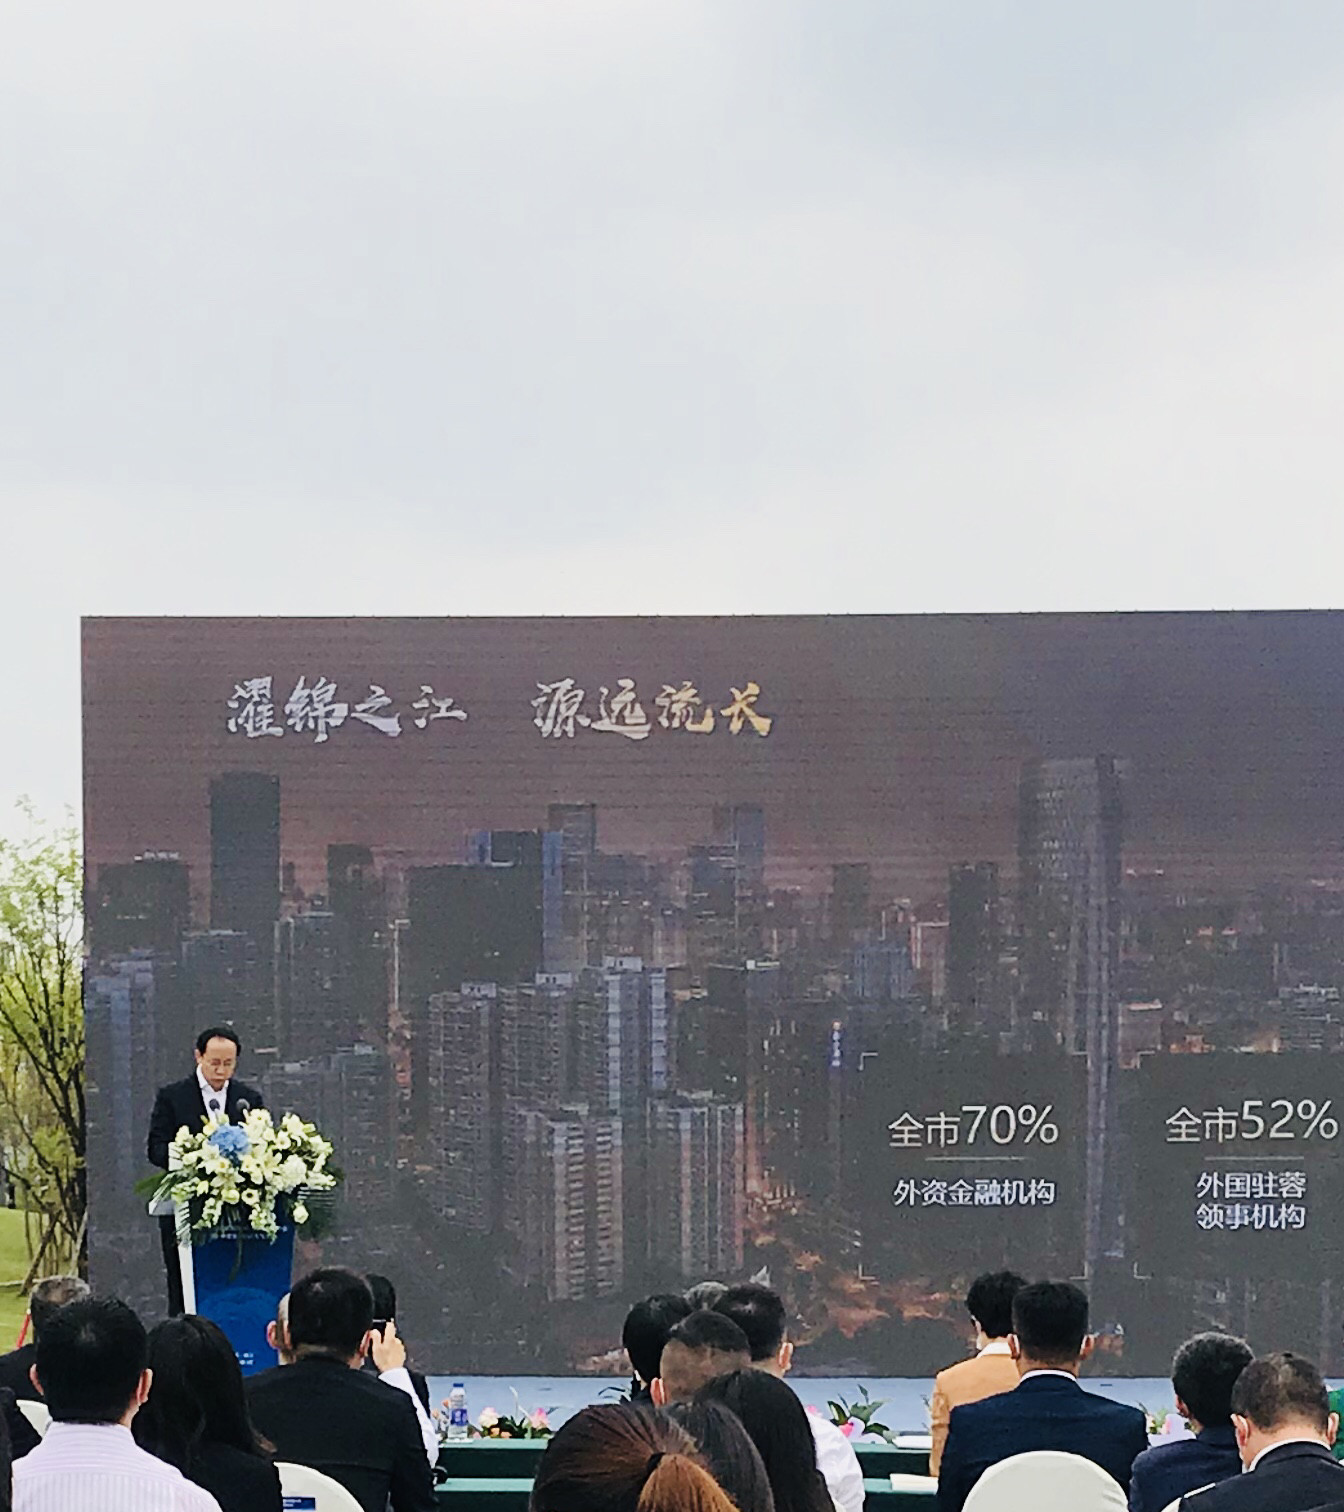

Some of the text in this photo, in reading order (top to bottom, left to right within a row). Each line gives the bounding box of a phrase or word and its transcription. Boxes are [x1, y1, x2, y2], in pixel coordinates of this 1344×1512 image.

[227, 675, 773, 744] 濯锦之江 源远流长
[888, 1104, 1059, 1149] 全市70%
[1166, 1100, 1340, 1144] 全市52%
[894, 1178, 1056, 1207] 外资金融机构
[1197, 1171, 1307, 1200] 外国驻蓉
[1197, 1203, 1307, 1231] 领事机构
